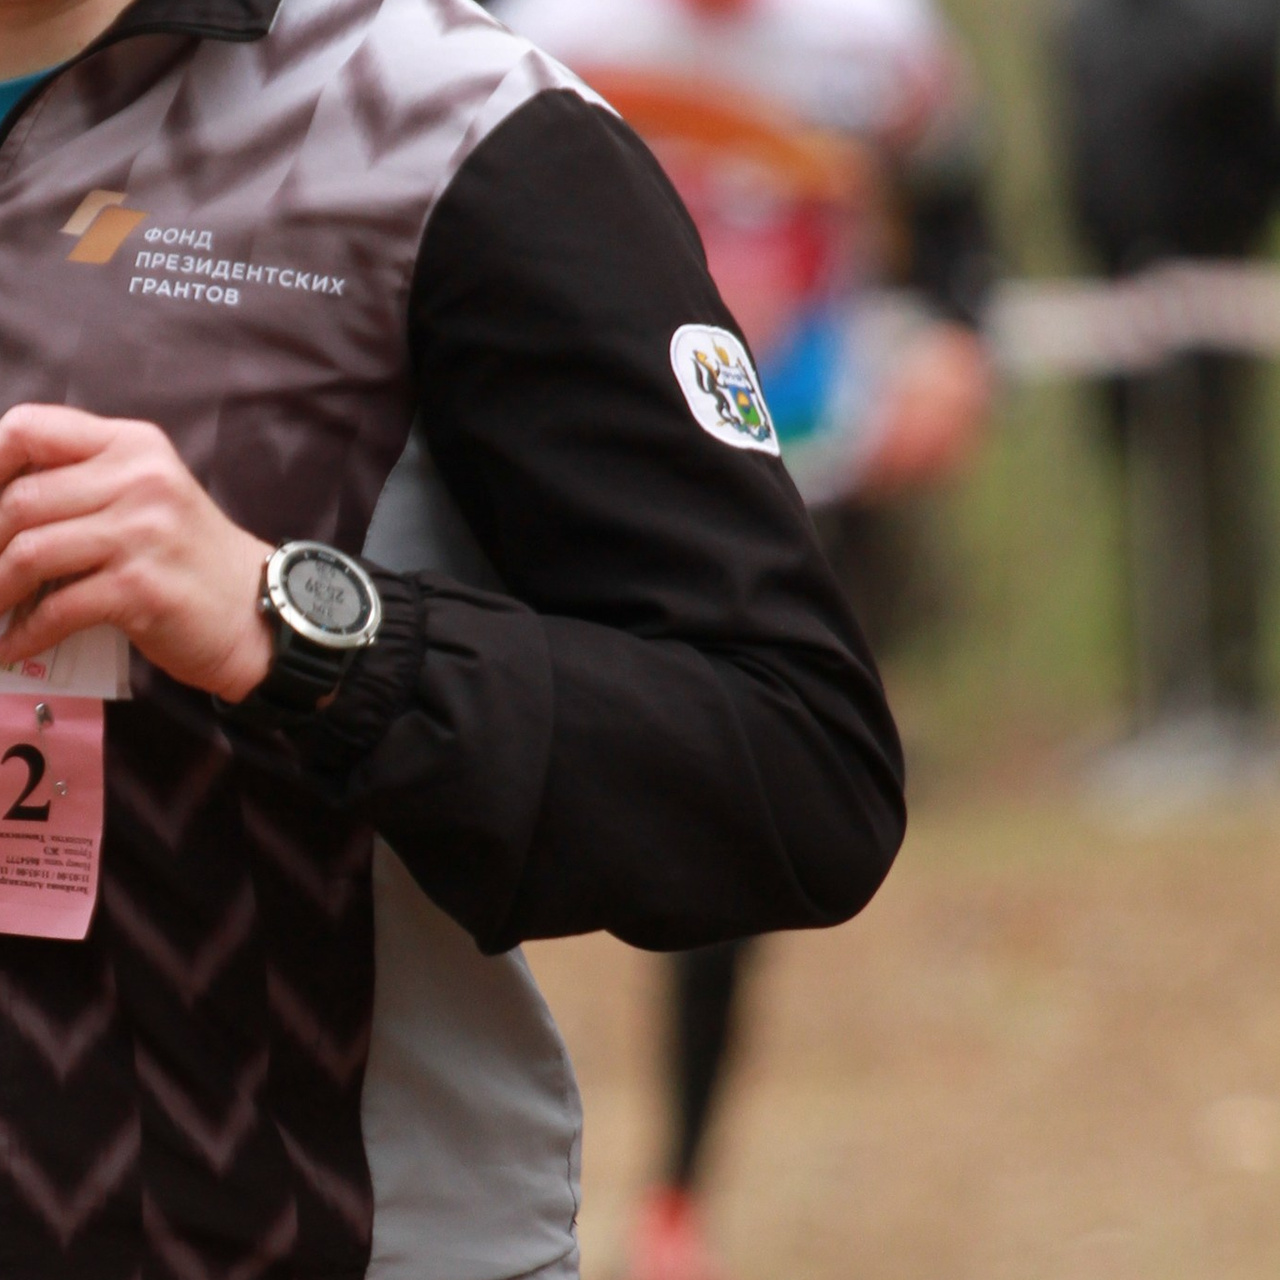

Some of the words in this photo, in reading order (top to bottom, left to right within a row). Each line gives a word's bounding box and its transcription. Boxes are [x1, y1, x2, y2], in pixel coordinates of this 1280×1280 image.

[143, 227, 213, 251] ФОНД
[134, 251, 346, 296] ПРЕЗИДЕНТСКИХ
[128, 276, 240, 306] ГРАНТОВ
